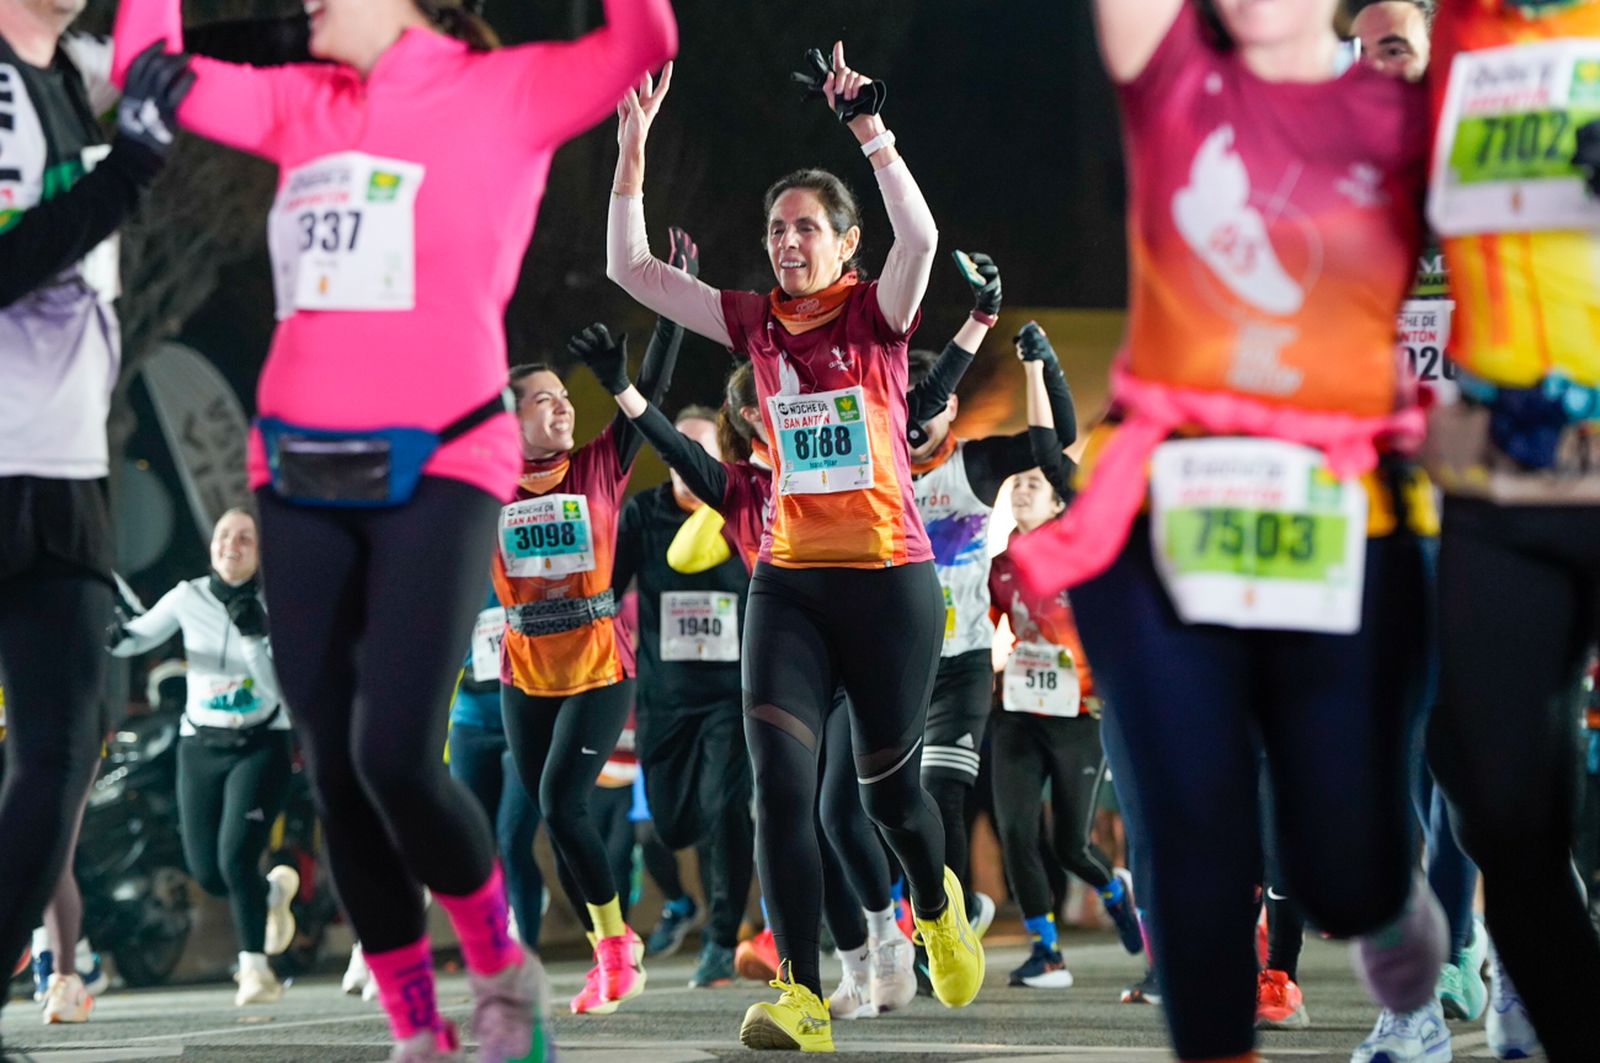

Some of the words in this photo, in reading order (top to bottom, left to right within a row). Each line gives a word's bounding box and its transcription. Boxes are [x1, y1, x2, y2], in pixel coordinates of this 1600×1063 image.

[1475, 109, 1567, 167] 7102
[298, 210, 361, 253] 337
[1421, 315, 1437, 326] DE
[789, 403, 818, 415] NOCHE
[818, 402, 829, 412] DE
[784, 417, 800, 429] SAN
[794, 425, 852, 460] 8788
[507, 516, 525, 527] SAN
[526, 512, 556, 524] ANTÓN
[517, 505, 543, 516] NOCHE
[514, 522, 576, 550] 3098
[1194, 508, 1316, 562] 7503
[677, 617, 722, 636] 1940
[1025, 669, 1058, 690] 518
